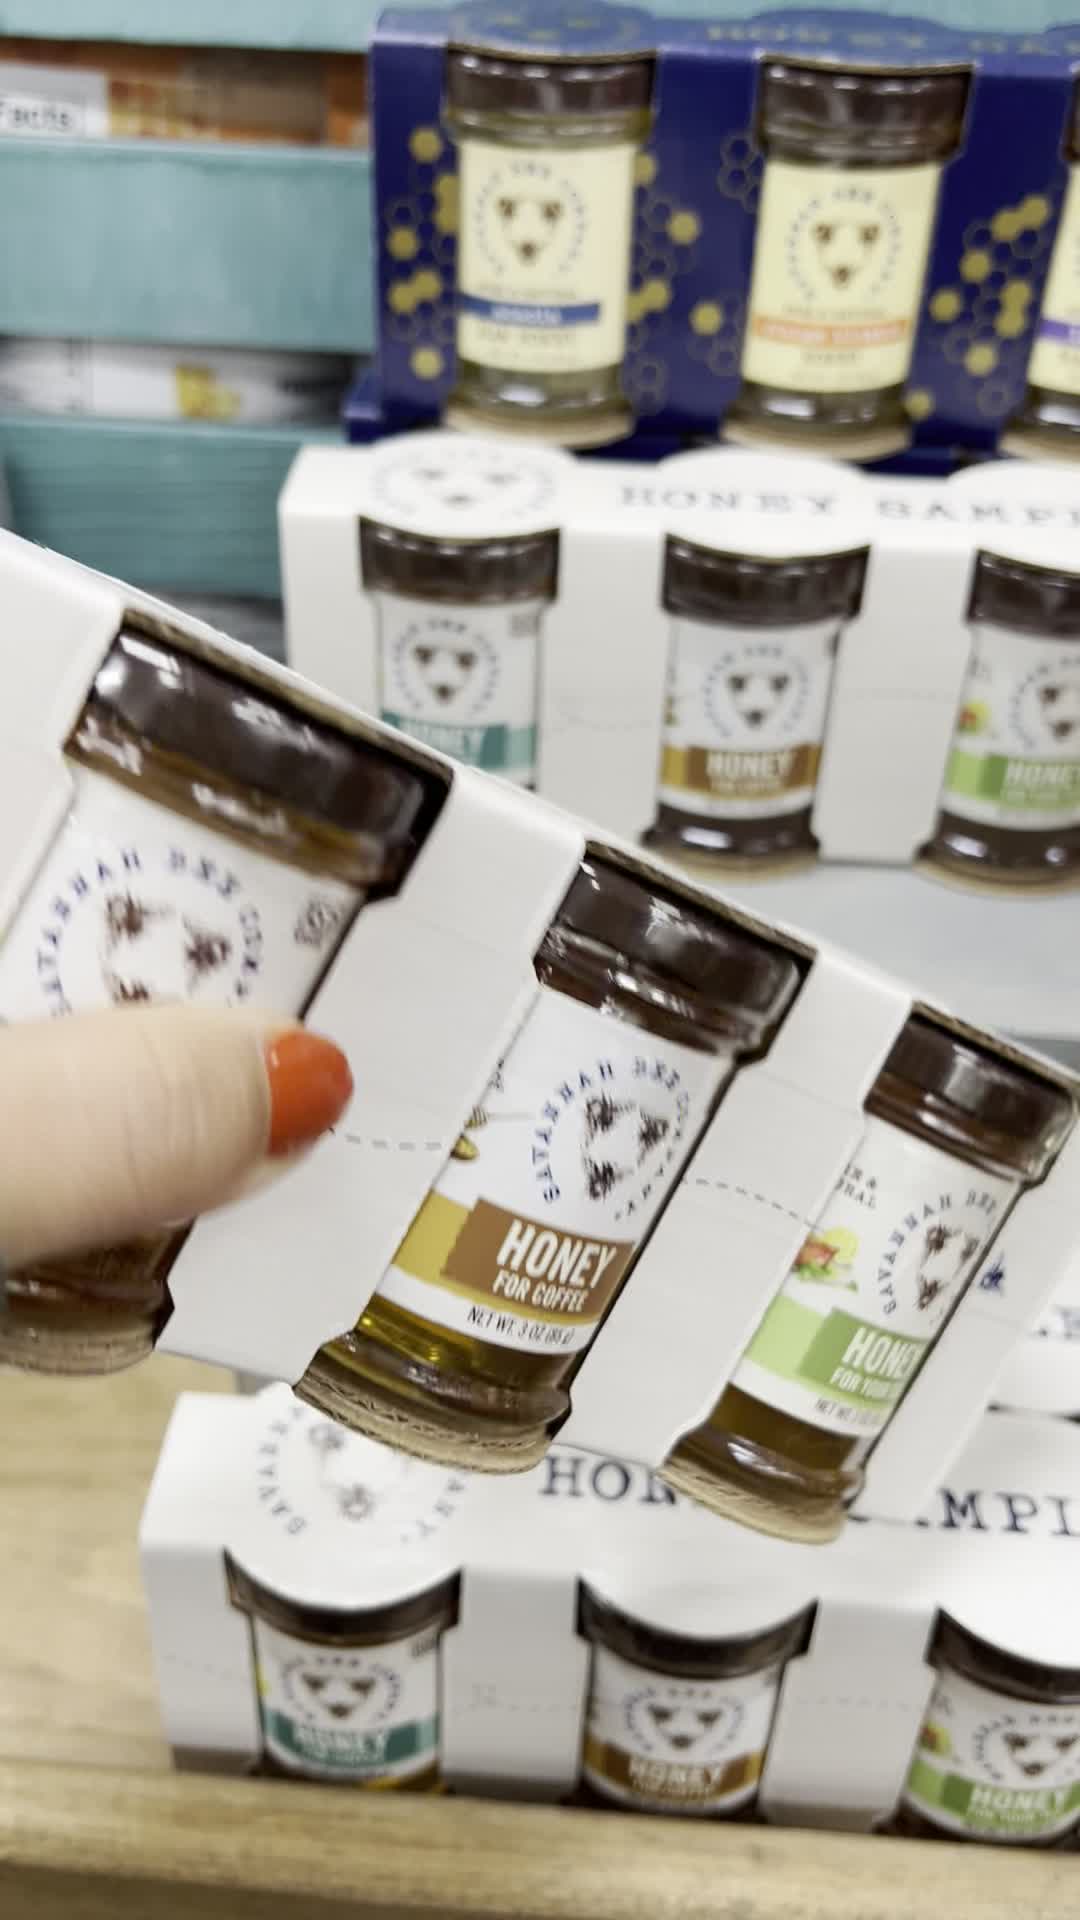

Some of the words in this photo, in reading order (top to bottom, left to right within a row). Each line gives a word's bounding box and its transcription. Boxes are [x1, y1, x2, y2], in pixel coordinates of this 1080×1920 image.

[621, 486, 838, 515] HONEY
[531, 1060, 614, 1203] SAVANNAH
[497, 1219, 617, 1289] HONEY
[493, 1269, 531, 1302] FOR
[531, 1281, 589, 1313] COFFEE
[467, 1305, 493, 1326] NET
[829, 1366, 863, 1392] FOR
[537, 1456, 680, 1505] HON
